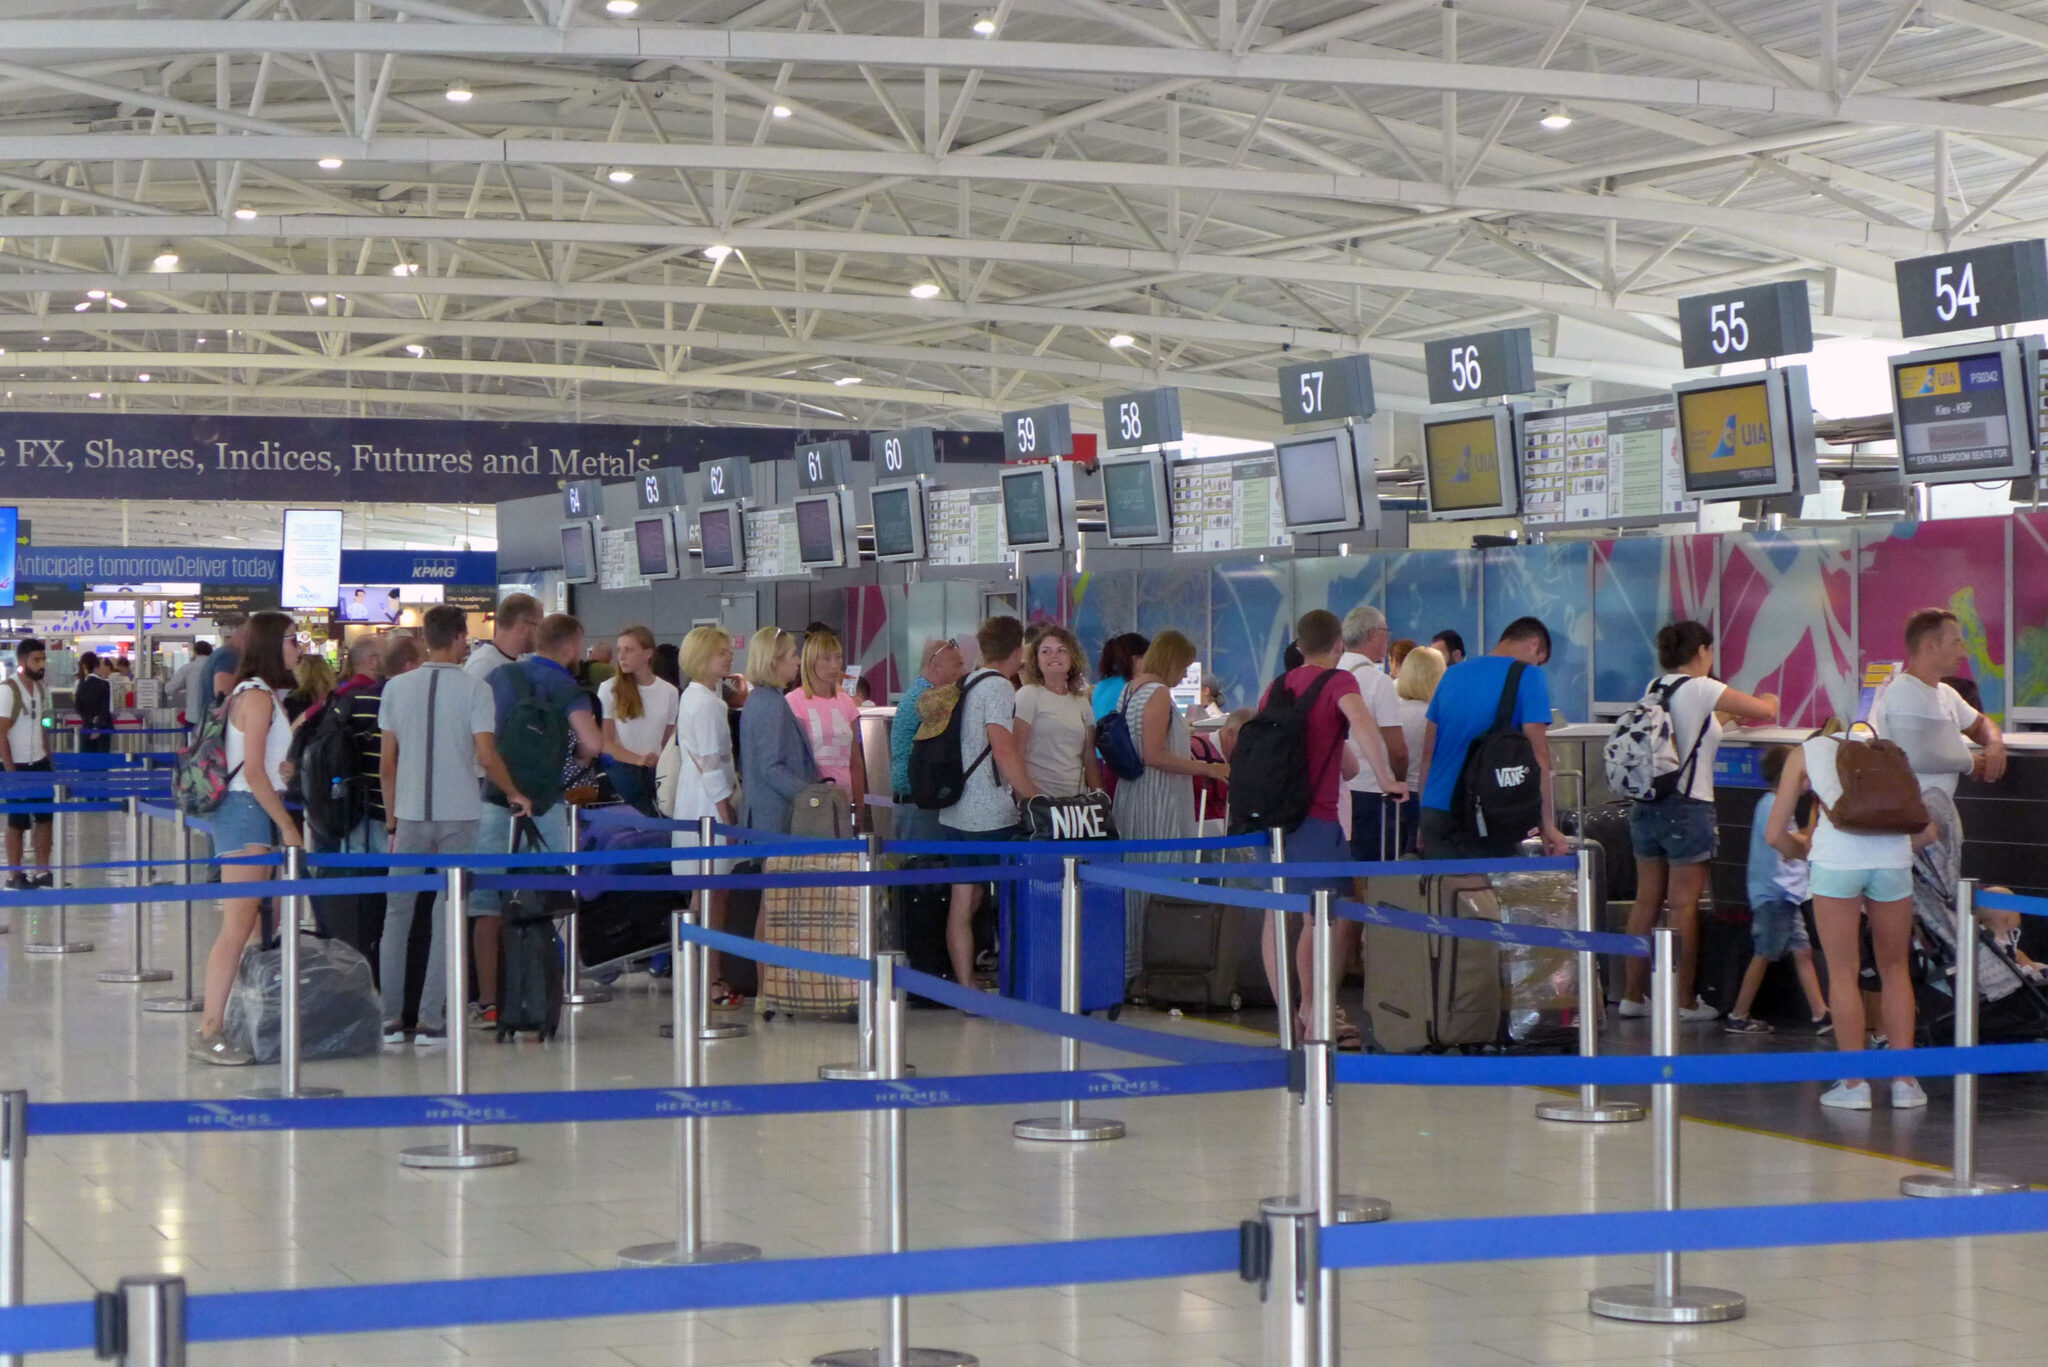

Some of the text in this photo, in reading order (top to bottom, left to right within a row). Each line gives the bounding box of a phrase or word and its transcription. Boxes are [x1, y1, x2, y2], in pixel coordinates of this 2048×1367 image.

[1935, 262, 1980, 322] 54
[1710, 301, 1749, 354] 55
[1451, 345, 1482, 392] 56
[1938, 371, 1956, 386] UIA
[1300, 371, 1323, 414] 57
[1017, 416, 1036, 453] 59
[1120, 401, 1142, 440] 58
[1741, 424, 1768, 447] UIA
[16, 439, 74, 473] FX,
[85, 438, 205, 475] Shares,
[216, 441, 342, 476] Indices,
[352, 444, 472, 474] Futures
[483, 446, 538, 475] and
[549, 448, 651, 477] Metals
[808, 450, 823, 482] 61
[885, 438, 902, 471] 60
[645, 476, 659, 504] 63
[710, 466, 725, 495] 62
[569, 487, 581, 513] 64
[16, 555, 94, 578] Anticipate
[232, 557, 279, 580] today.
[411, 565, 456, 578] KPMG
[1495, 765, 1526, 788] VANS
[1050, 804, 1107, 840] NIKE
[875, 1091, 949, 1103] HERMES
[1088, 1080, 1159, 1093] HERMES
[187, 1113, 272, 1125] HERMES
[426, 1107, 508, 1121] HERMES
[655, 1100, 733, 1112] HERMES
